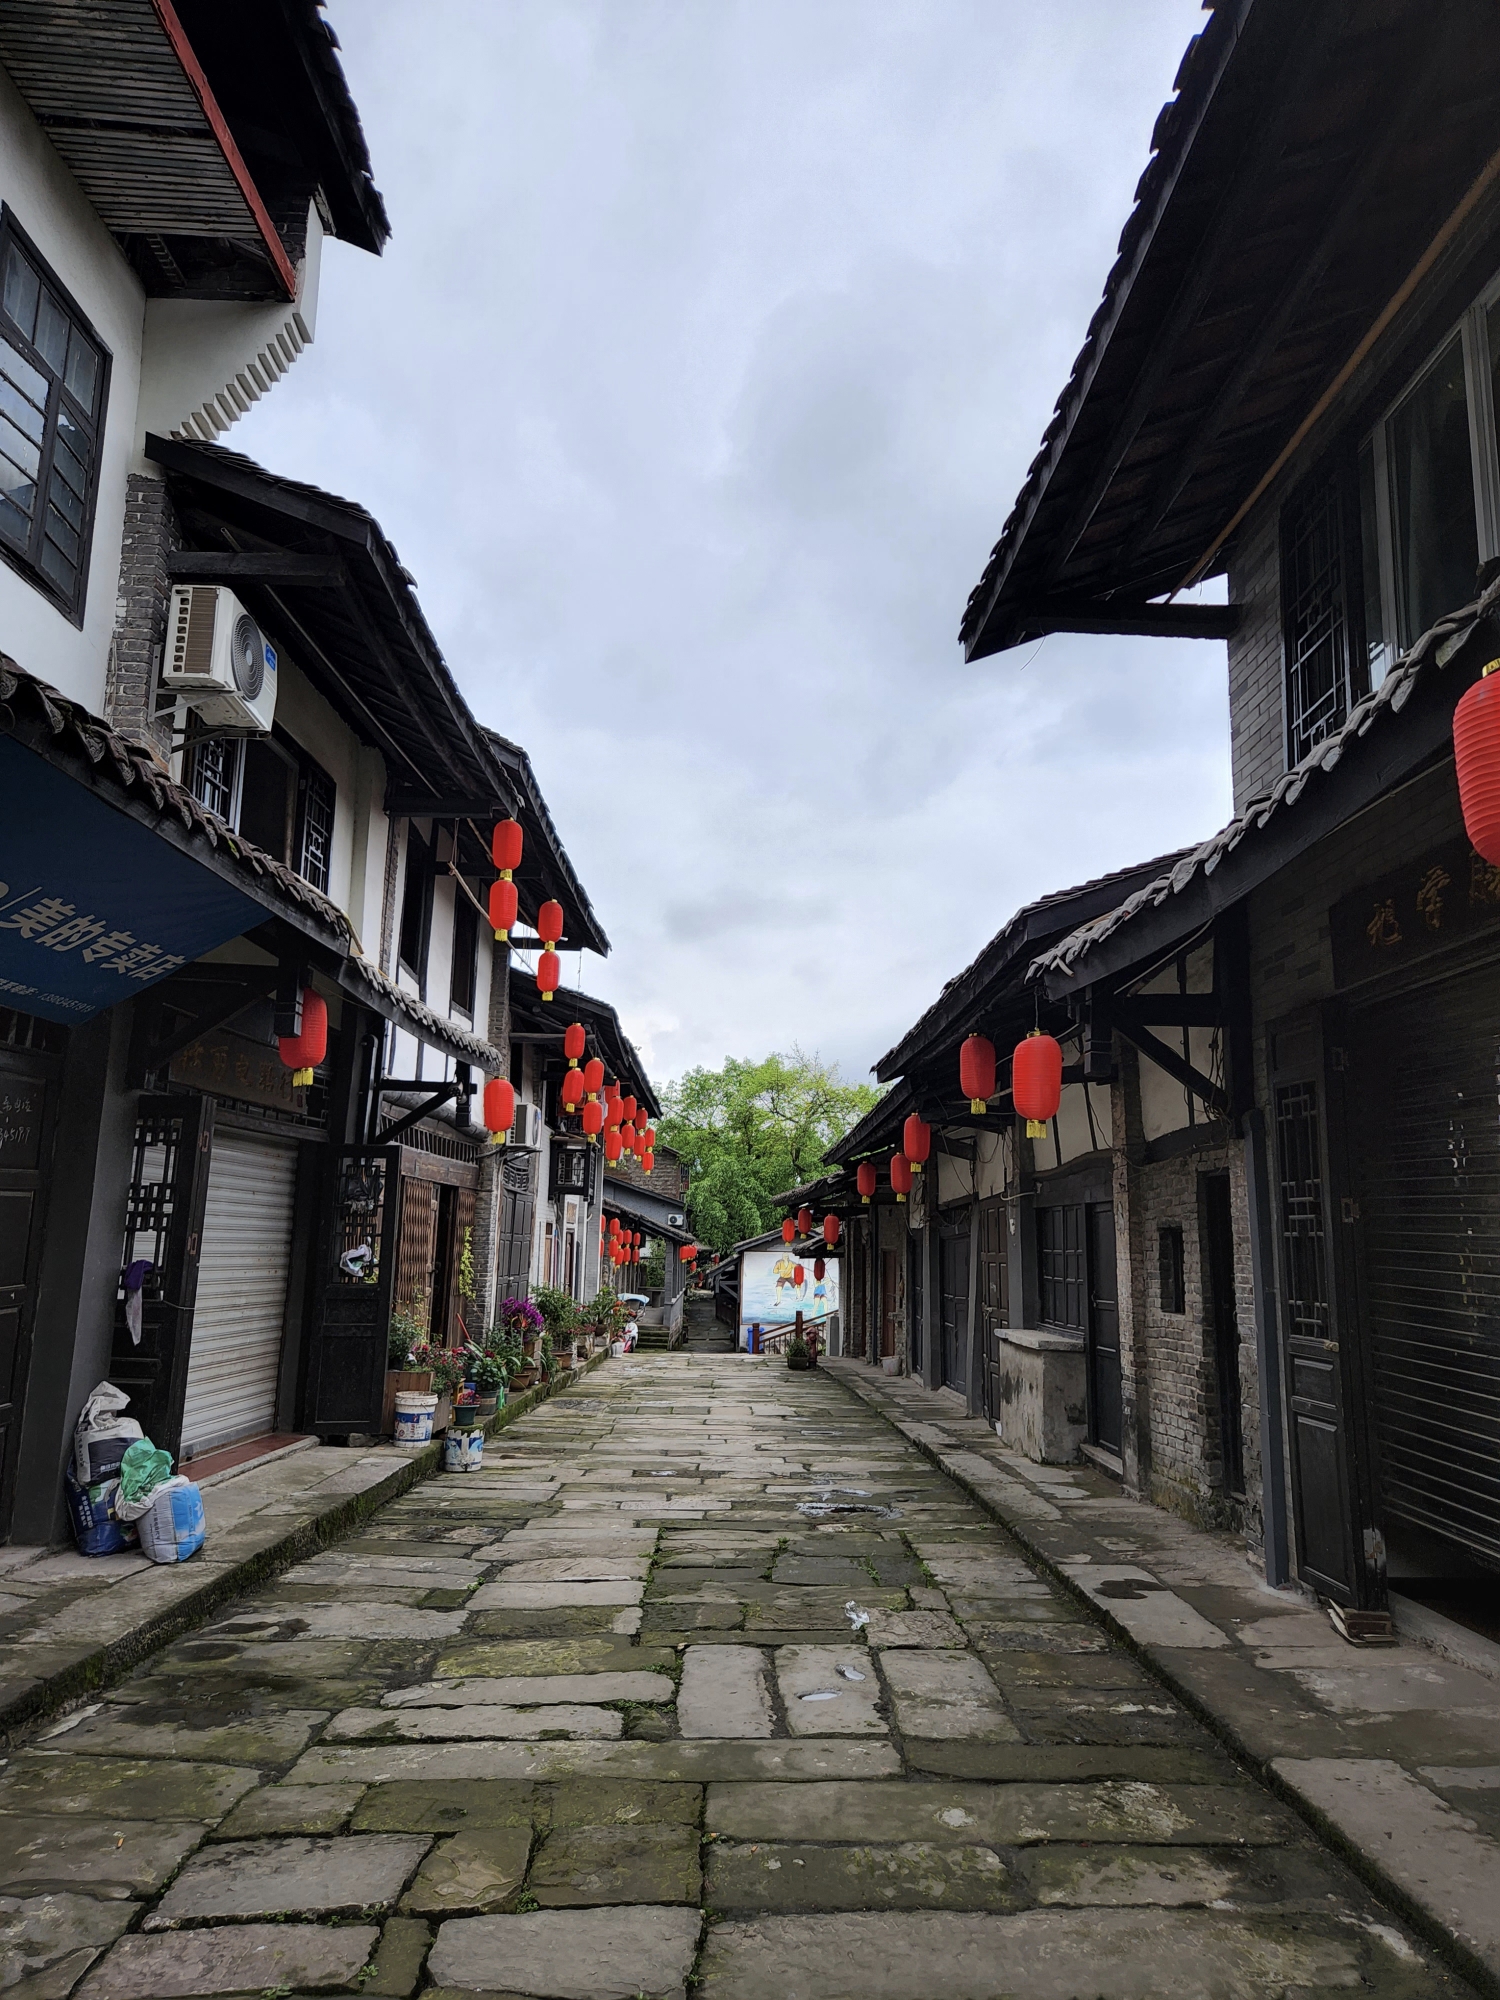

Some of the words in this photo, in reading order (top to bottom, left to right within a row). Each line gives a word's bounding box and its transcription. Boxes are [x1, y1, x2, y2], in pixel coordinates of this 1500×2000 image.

[0, 897, 187, 981] 美的专卖店
